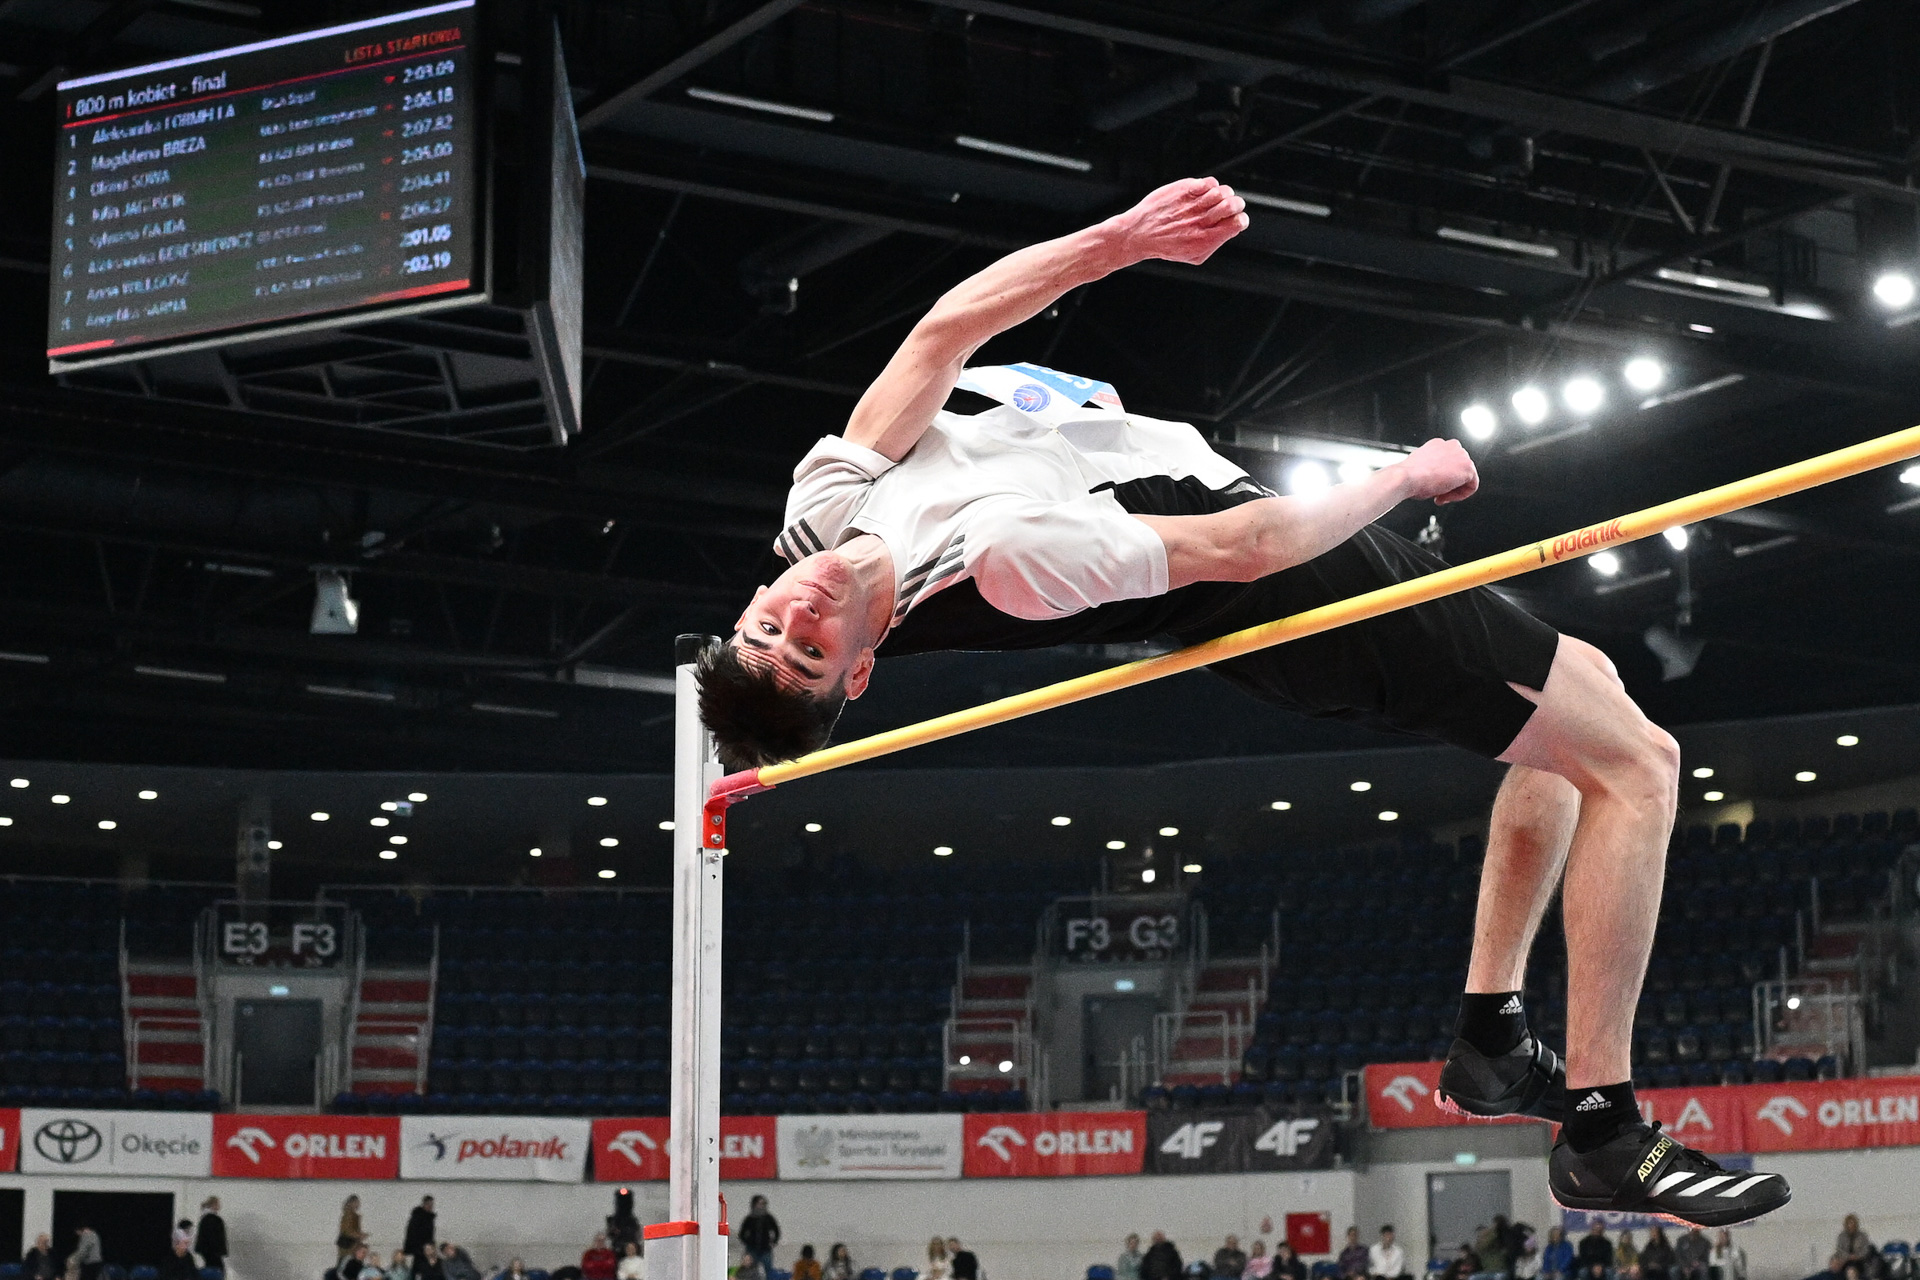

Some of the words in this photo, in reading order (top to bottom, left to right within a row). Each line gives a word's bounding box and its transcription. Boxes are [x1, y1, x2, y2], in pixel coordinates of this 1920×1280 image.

[75, 95, 105, 116] 800
[108, 93, 124, 109] m
[127, 83, 176, 107] kobiet
[192, 70, 227, 94] final
[69, 134, 76, 149] 1
[67, 160, 77, 176] 2
[1552, 519, 1624, 561] polanik
[224, 922, 268, 955] E3
[293, 923, 336, 956] F3
[1067, 916, 1110, 950] F3
[1130, 915, 1179, 949] G3
[1576, 1101, 1612, 1112] adidas
[1817, 1095, 1918, 1127] ORLEN
[121, 1133, 200, 1155] Okęcie
[284, 1133, 386, 1159] ORLEN
[456, 1133, 568, 1163] polanik
[1034, 1129, 1134, 1156] ORLEN
[1159, 1121, 1224, 1159] 4F
[1255, 1118, 1319, 1157] 4F
[1637, 1137, 1672, 1183] ADIZERO
